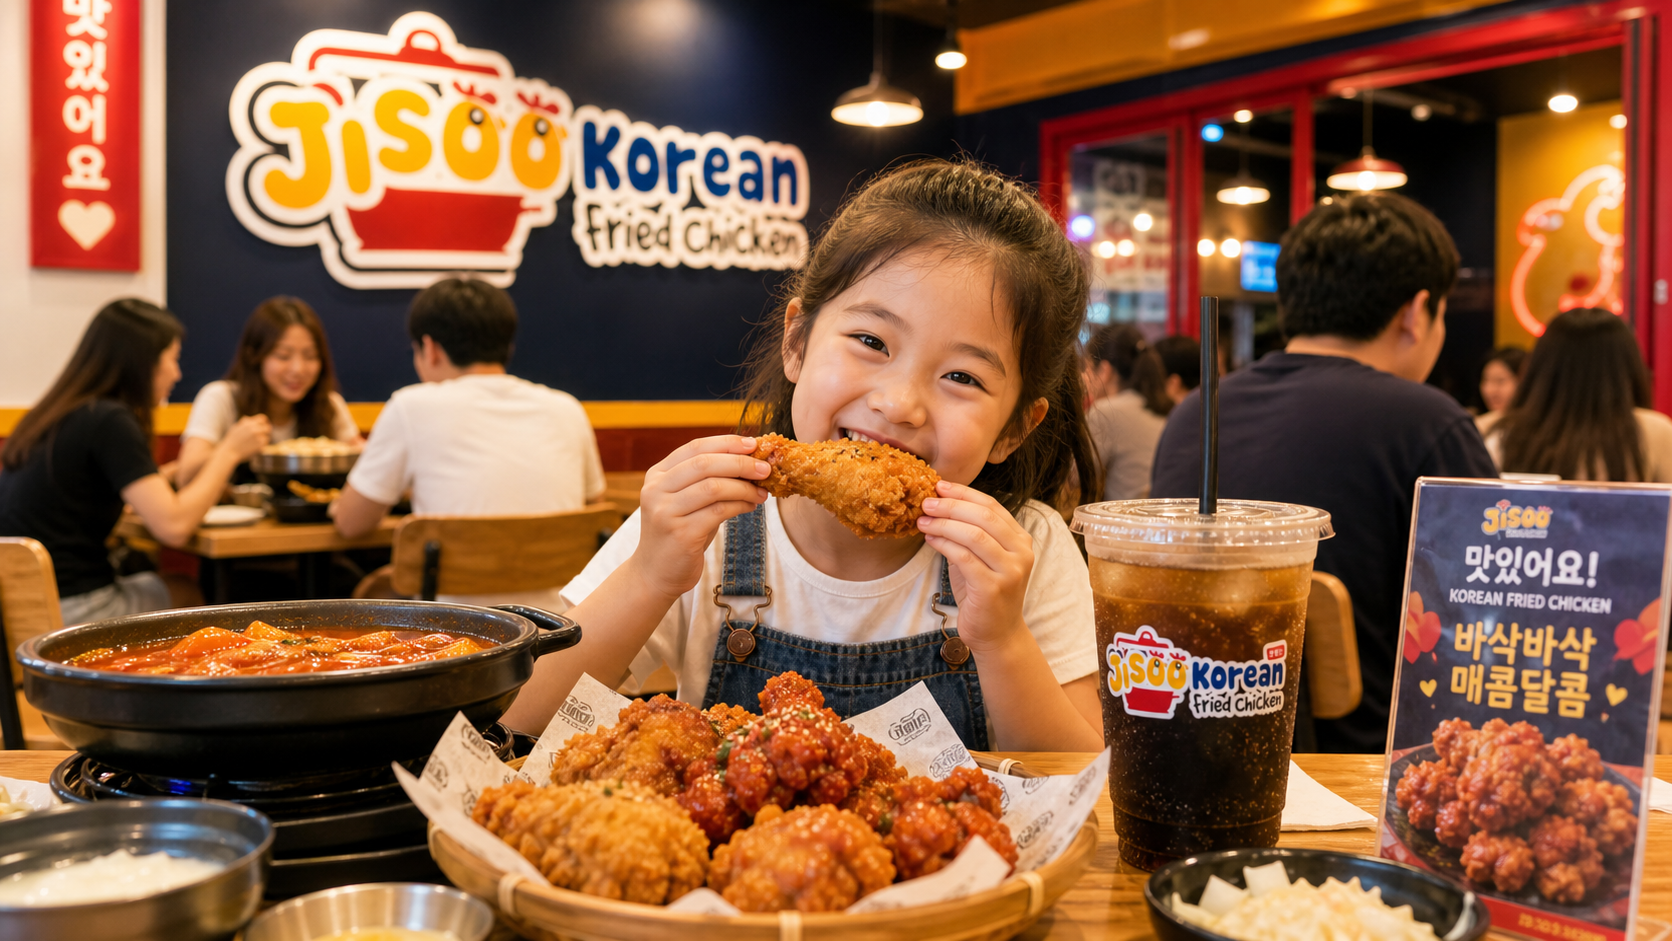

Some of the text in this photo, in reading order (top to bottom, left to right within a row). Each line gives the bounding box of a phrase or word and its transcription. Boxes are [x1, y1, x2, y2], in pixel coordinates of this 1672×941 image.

[62, 0, 112, 191] 맛있어요
[583, 121, 798, 206] Korean
[683, 214, 798, 256] Chicken
[1465, 544, 1600, 589] 맛있어요!
[1449, 587, 1613, 614] KOREAN FRIED CHICKEN
[1454, 621, 1598, 672] 바삭바삭
[1192, 661, 1284, 690] Korean
[1450, 663, 1592, 719] 매콤달콤
[1235, 691, 1282, 712] Chicken
